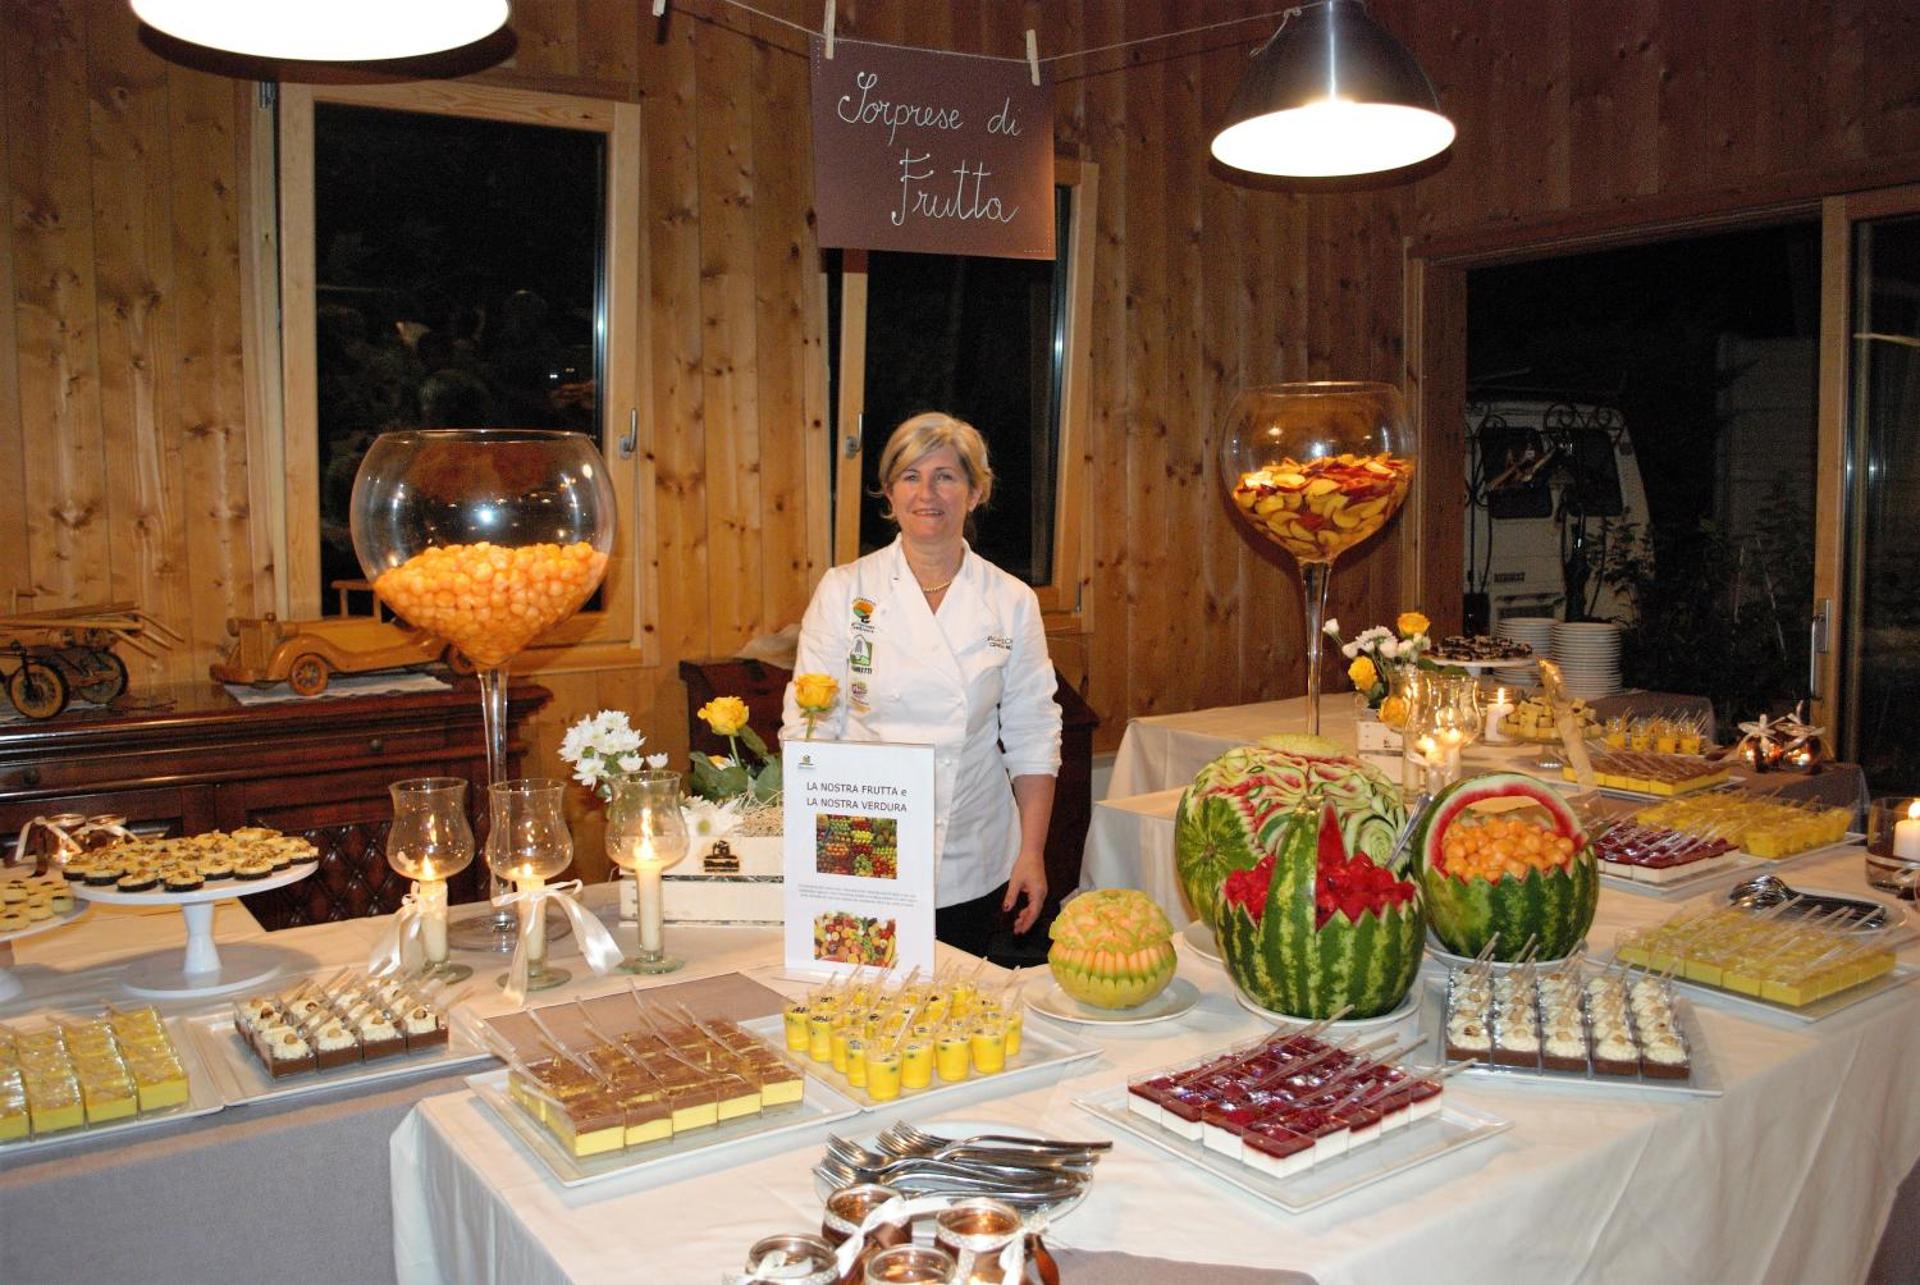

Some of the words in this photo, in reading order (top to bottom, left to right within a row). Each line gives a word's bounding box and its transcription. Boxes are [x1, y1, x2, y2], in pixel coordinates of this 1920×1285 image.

[838, 71, 964, 146] Sorprese
[987, 96, 1023, 136] di
[891, 147, 1020, 226] Frutta
[806, 781, 818, 791] LA
[820, 782, 858, 793] NOSTRA
[861, 785, 898, 795] FRUTTA
[900, 788, 907, 796] e
[806, 797, 818, 806] LA
[820, 798, 858, 809] NOSTRA
[861, 800, 907, 812] VERDURA
